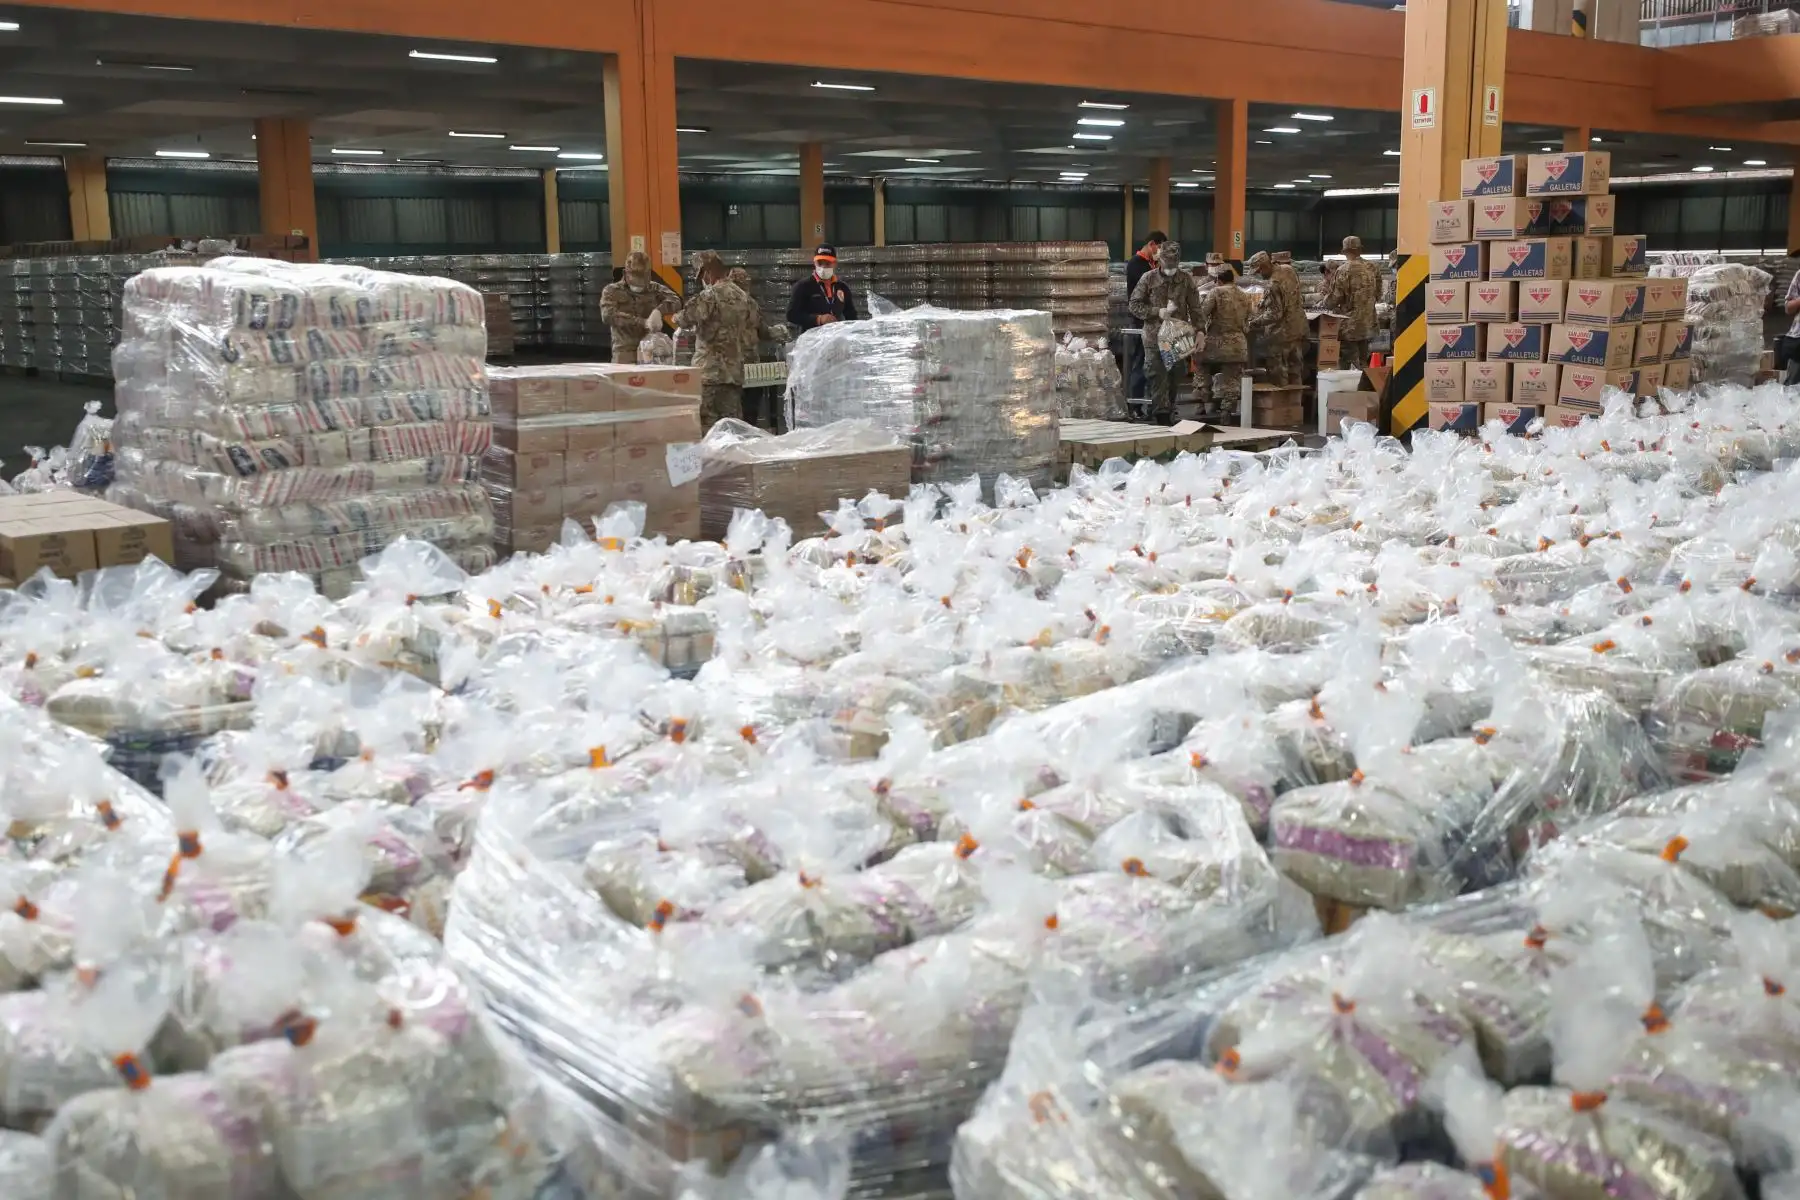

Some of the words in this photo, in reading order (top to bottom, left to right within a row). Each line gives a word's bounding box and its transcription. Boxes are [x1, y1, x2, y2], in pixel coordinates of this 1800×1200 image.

[1482, 186, 1512, 194] GALLETAS
[1550, 183, 1582, 191] GALLETAS
[1235, 232, 1241, 241] S
[1450, 270, 1478, 278] GALLETAS
[1571, 354, 1604, 365] GALLETAS
